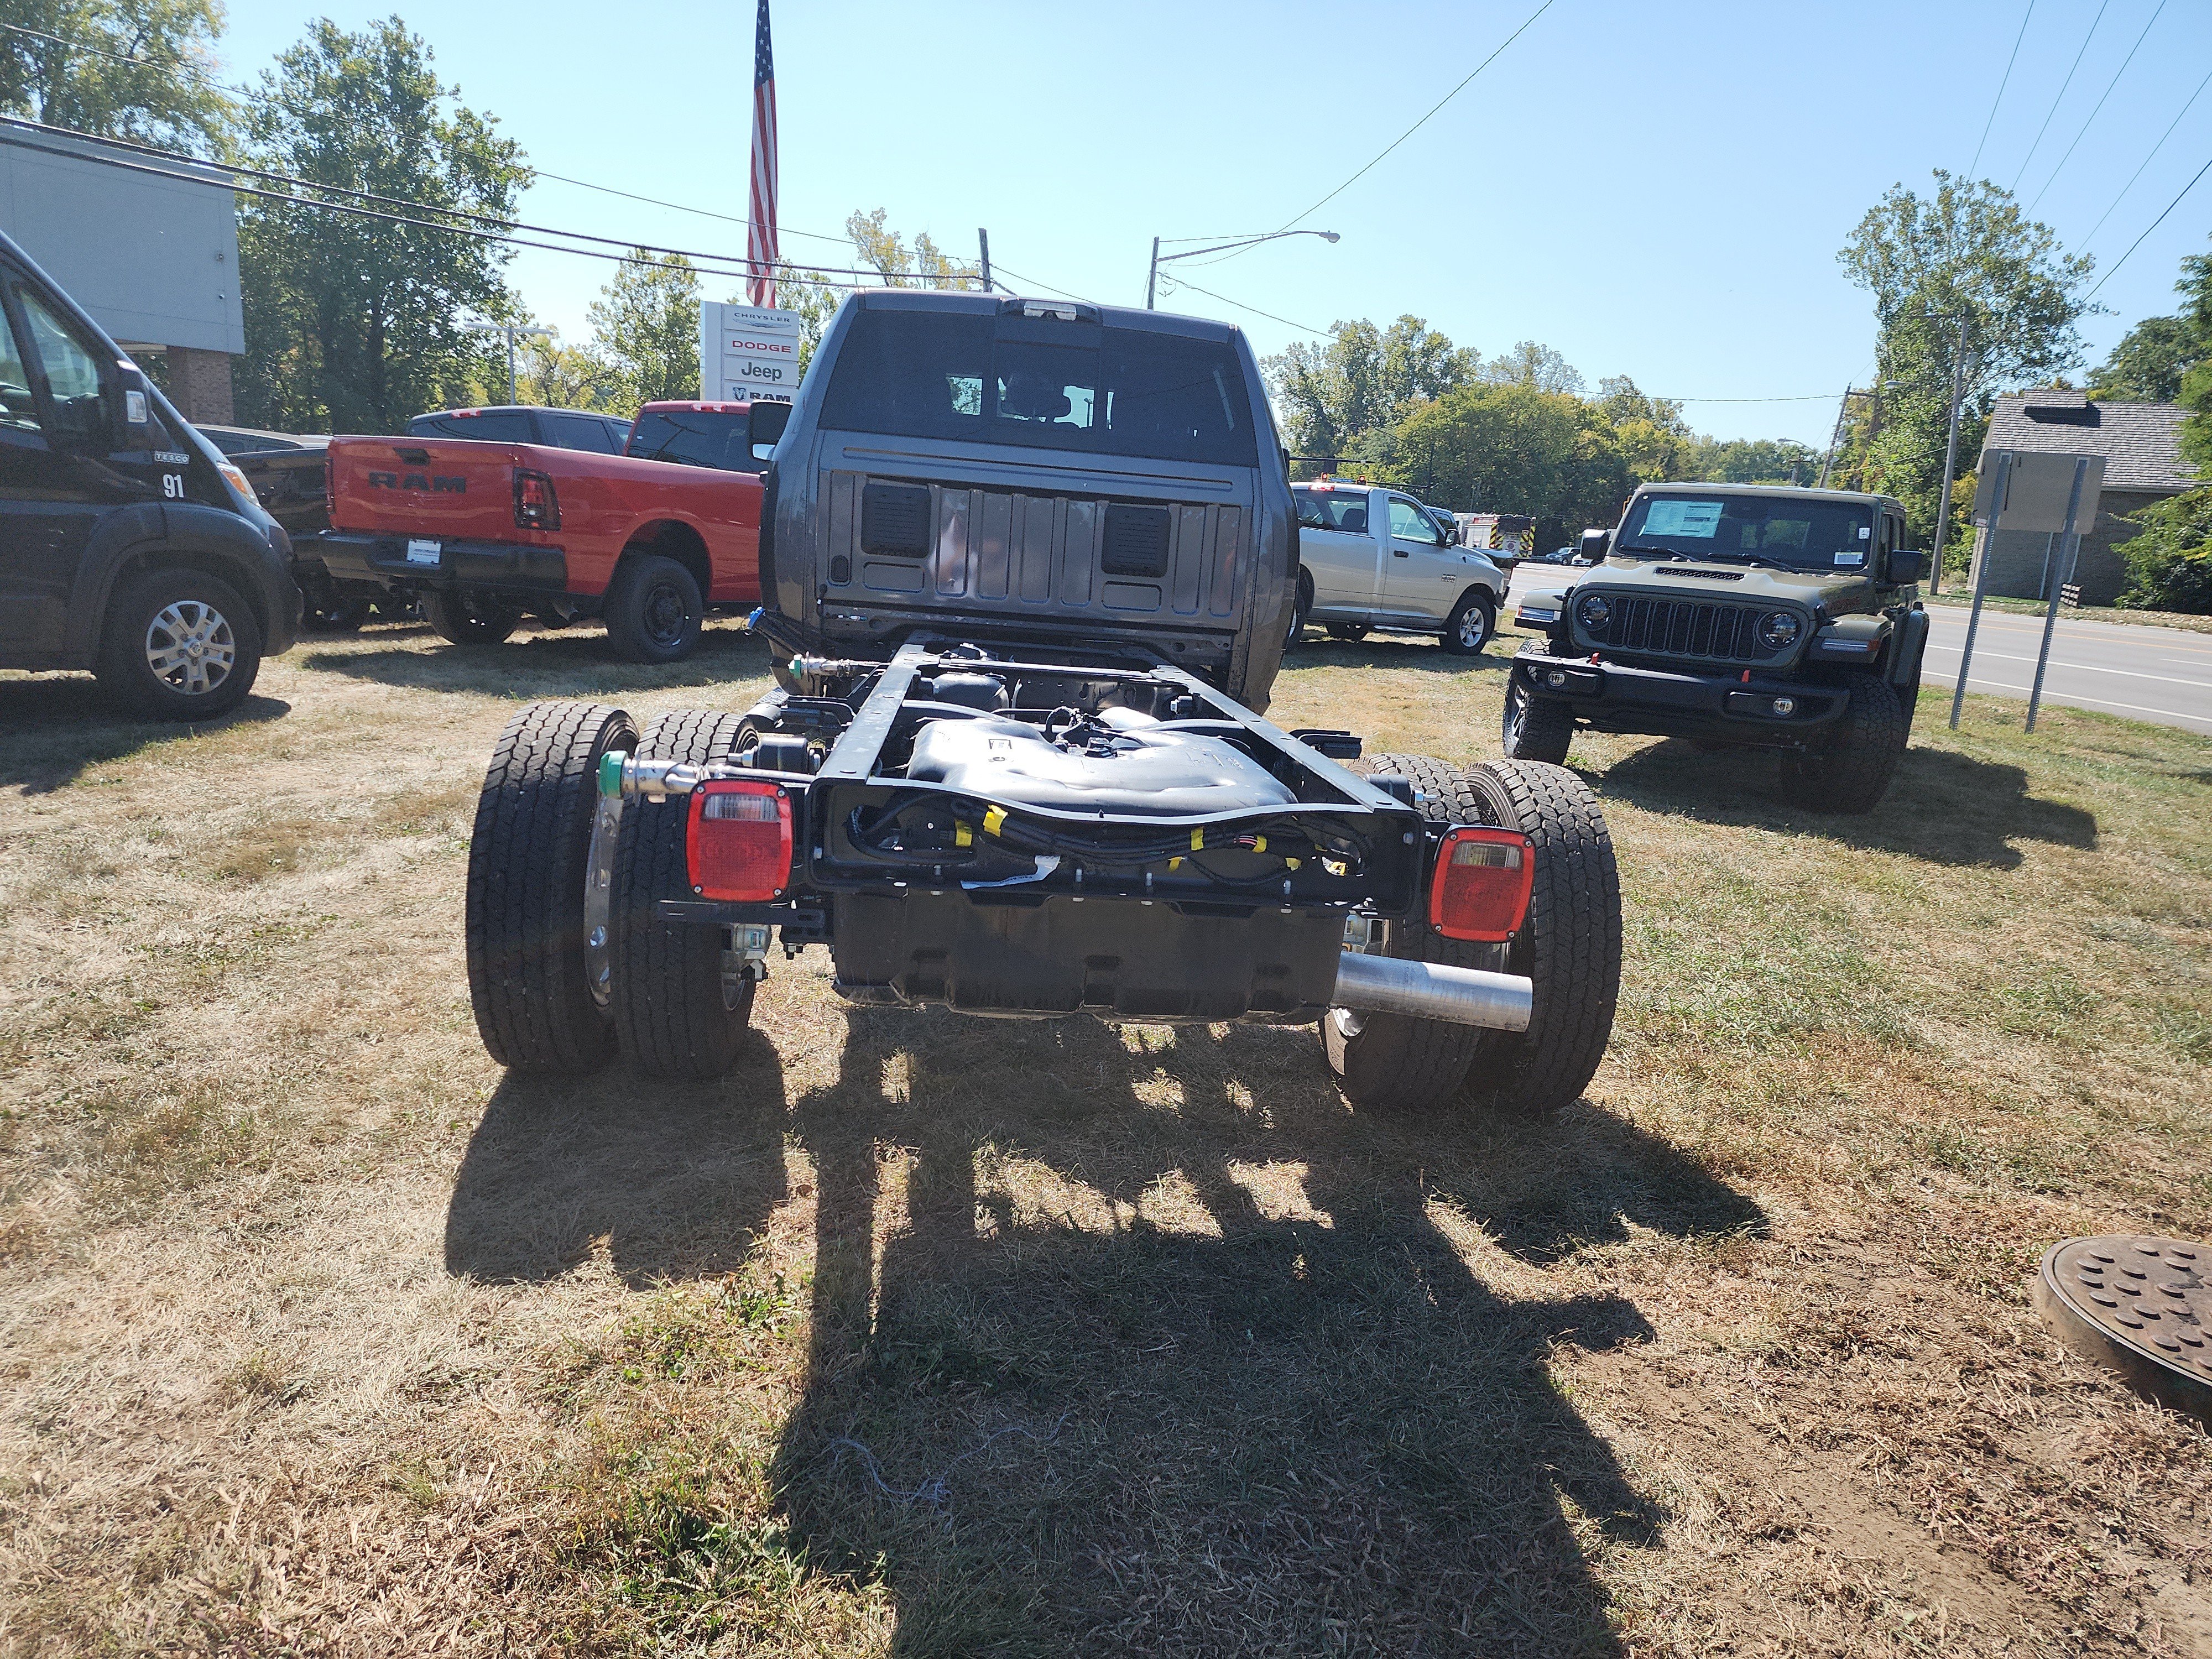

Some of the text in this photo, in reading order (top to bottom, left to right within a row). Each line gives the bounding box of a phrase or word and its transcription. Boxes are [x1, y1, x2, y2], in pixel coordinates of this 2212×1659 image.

[734, 312, 790, 322] CHRYSLER
[732, 340, 791, 353] DODGE
[741, 362, 782, 382] Jeep
[749, 392, 791, 403] RAM
[155, 453, 189, 462] TESCO
[163, 474, 184, 498] 91
[368, 471, 467, 494] RAM
